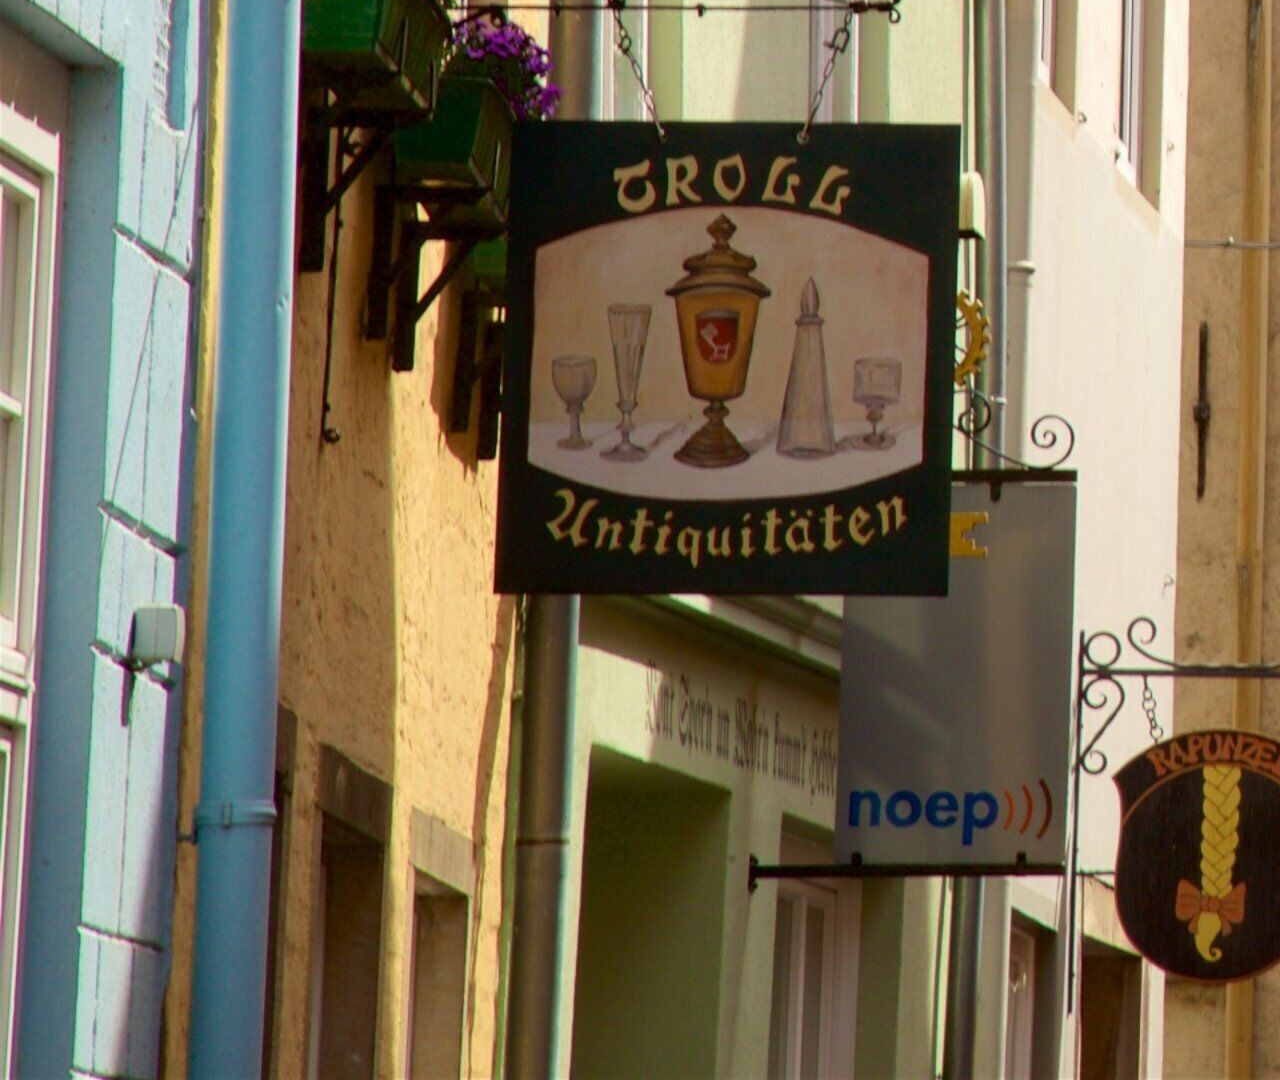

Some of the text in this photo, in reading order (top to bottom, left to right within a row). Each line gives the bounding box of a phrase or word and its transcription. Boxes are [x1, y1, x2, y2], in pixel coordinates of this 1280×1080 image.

[613, 152, 851, 216] TROLL
[545, 487, 908, 569] Antiquitäten
[848, 789, 1000, 846] noep
